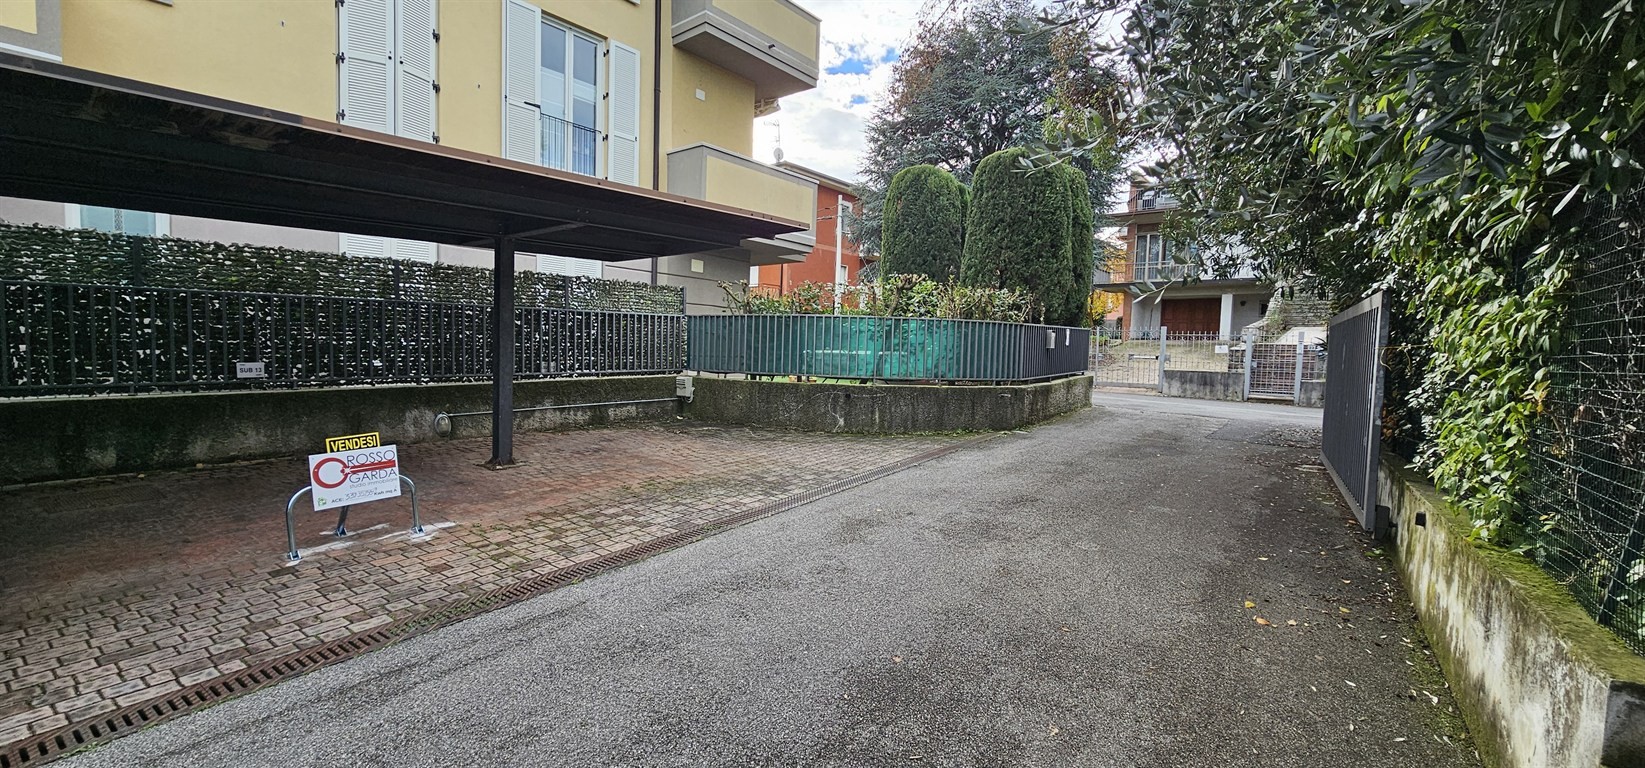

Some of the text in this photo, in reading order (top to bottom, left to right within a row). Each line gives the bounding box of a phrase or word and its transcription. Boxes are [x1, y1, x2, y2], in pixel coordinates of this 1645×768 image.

[330, 436, 377, 452] VENDESI
[346, 450, 395, 467] ROSSO
[348, 468, 398, 484] GARDA
